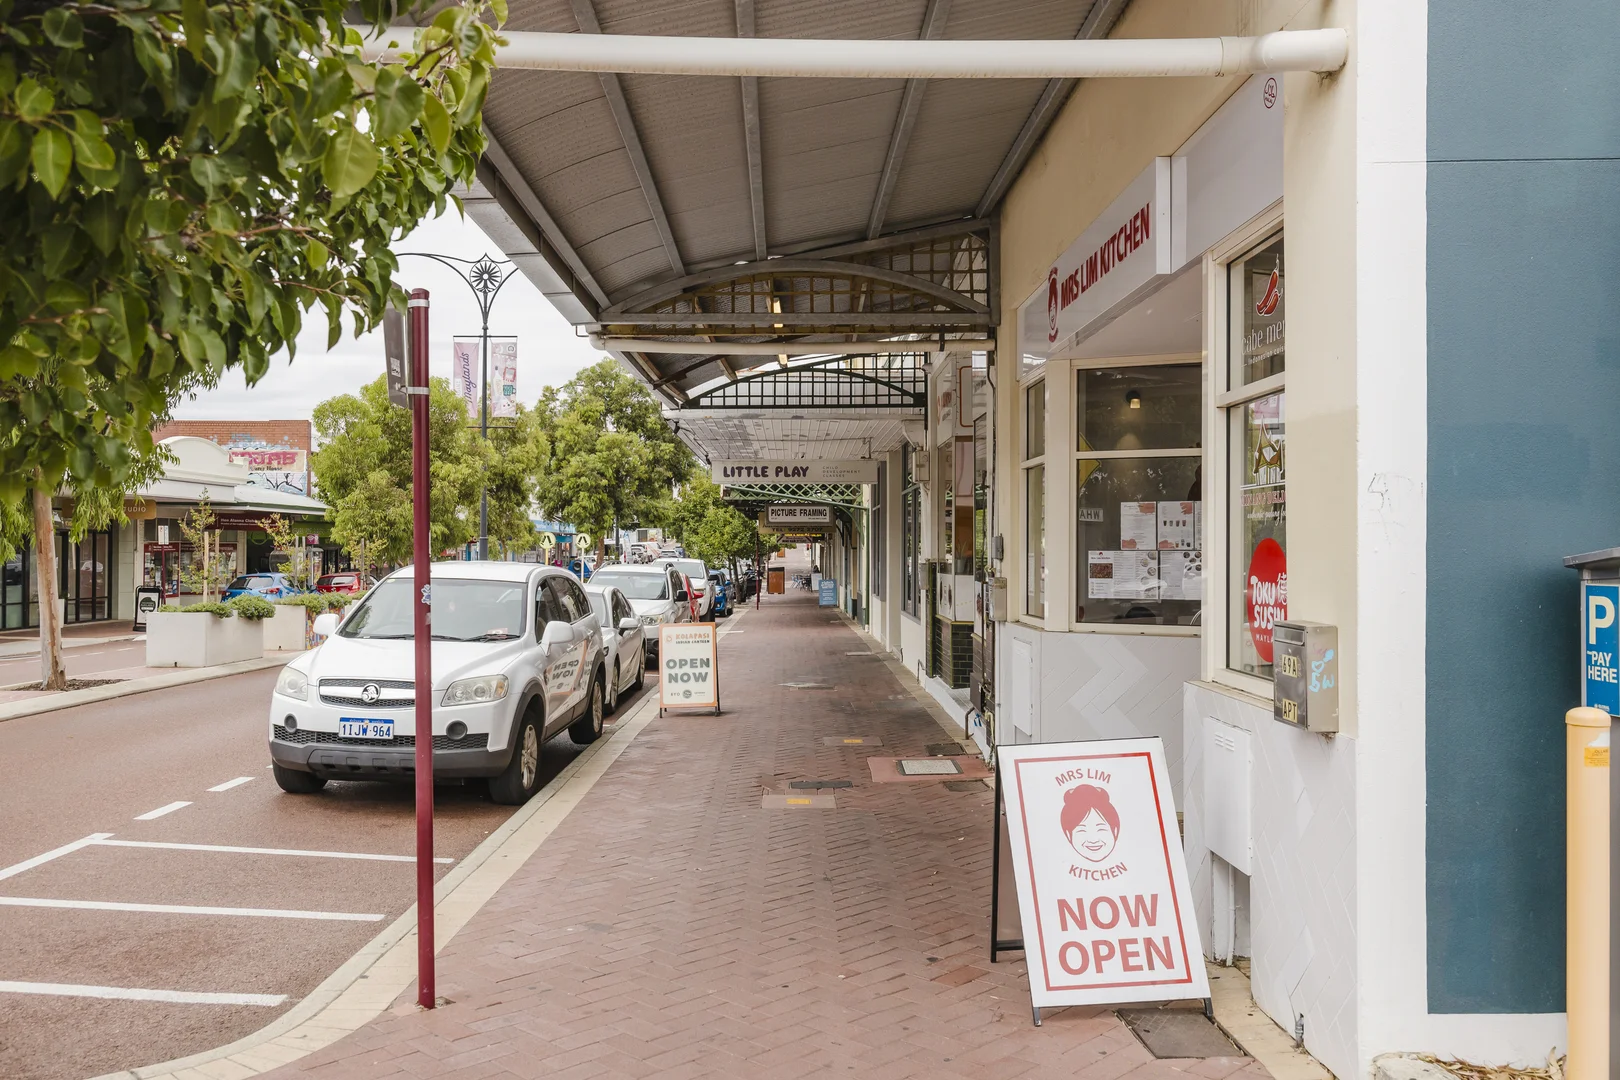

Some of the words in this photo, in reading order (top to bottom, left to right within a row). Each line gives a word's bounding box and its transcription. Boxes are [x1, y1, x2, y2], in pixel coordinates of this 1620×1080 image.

[1061, 268, 1079, 311] MRS
[1081, 250, 1098, 294] LIM
[1100, 202, 1150, 278] KITCHEN
[1242, 329, 1263, 355] cabe
[462, 352, 477, 403] Maylands
[723, 466, 769, 478] LITTLE
[775, 466, 809, 478] PLAY
[770, 508, 797, 517] PICTURE
[800, 508, 827, 517] FRAMING
[1250, 575, 1276, 606] TOKU
[1254, 605, 1285, 630] SUSHI
[1588, 595, 1615, 645] P
[666, 658, 710, 669] OPEN
[1283, 655, 1297, 676] 69A
[1591, 651, 1612, 667] PAY
[668, 672, 709, 683] NOW
[1588, 666, 1618, 684] HERE
[1284, 701, 1297, 720] APT
[373, 725, 391, 737] 964
[1055, 768, 1084, 786] MRS
[1087, 769, 1112, 784] LIM
[1068, 862, 1128, 881] KITCHEN
[1057, 893, 1158, 931] NOW
[1058, 936, 1175, 975] OPEN
